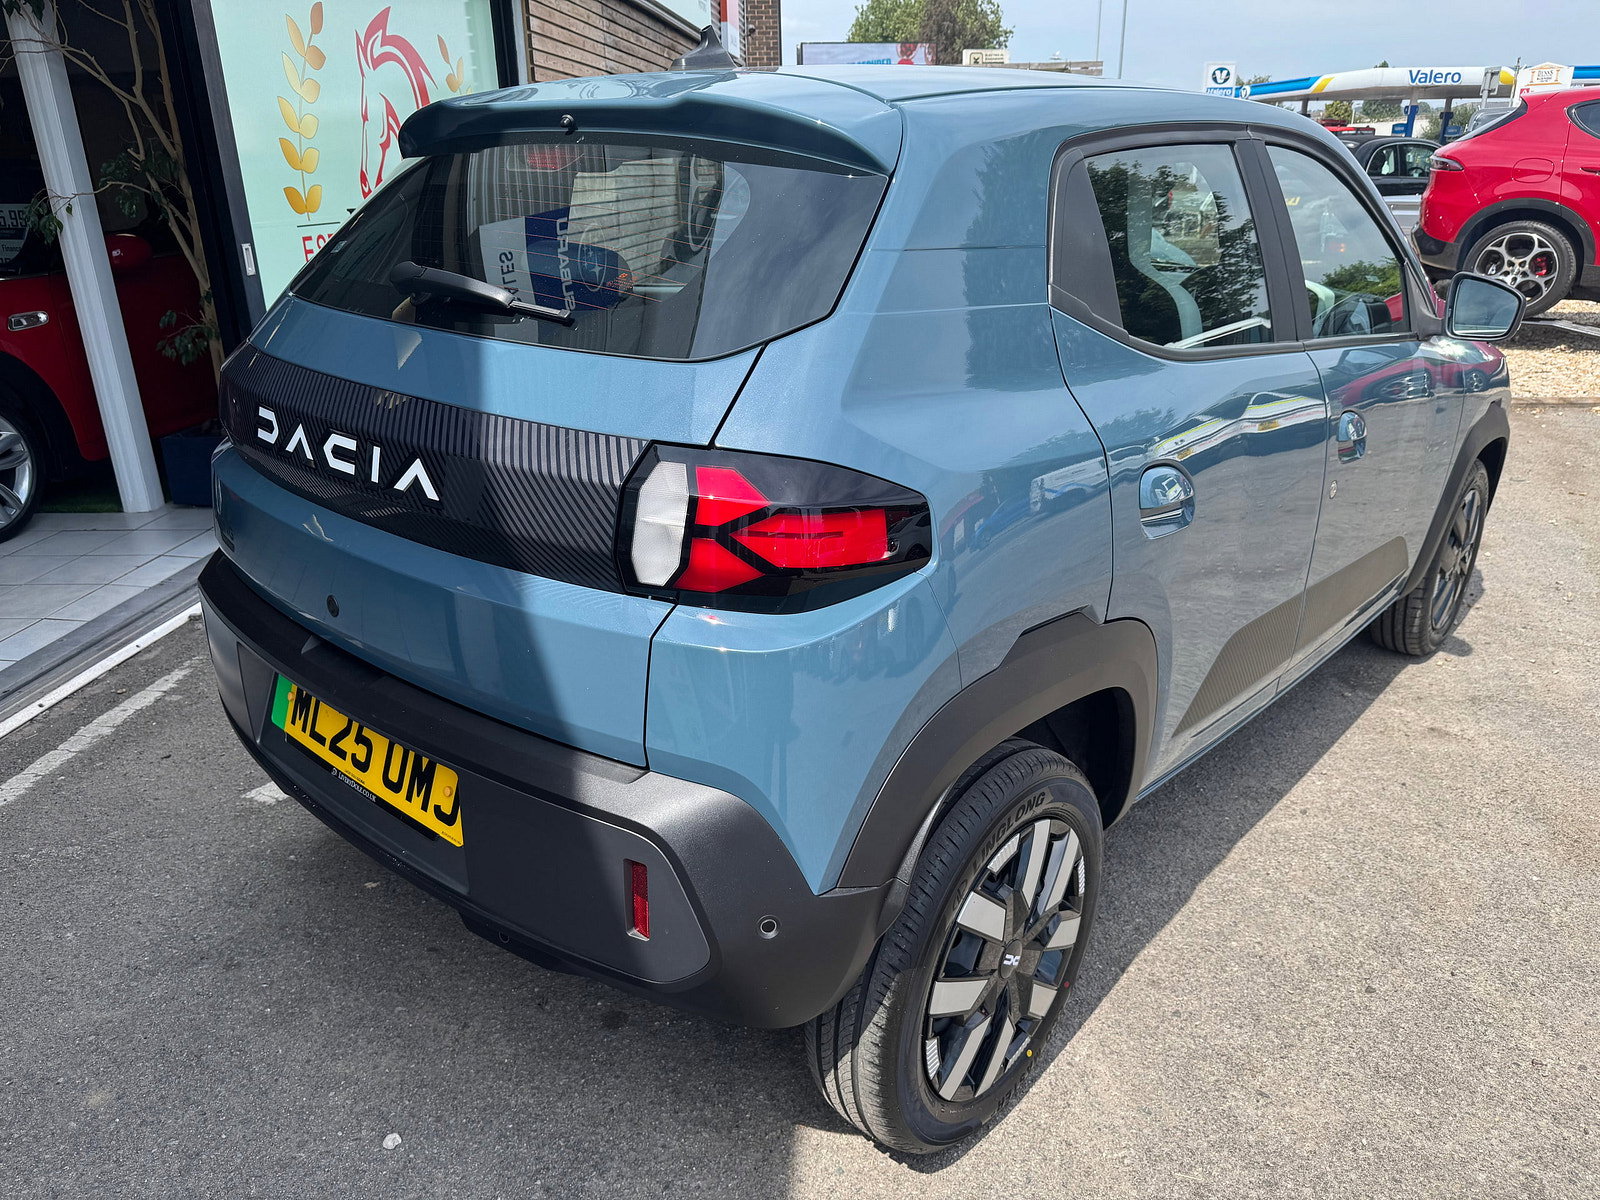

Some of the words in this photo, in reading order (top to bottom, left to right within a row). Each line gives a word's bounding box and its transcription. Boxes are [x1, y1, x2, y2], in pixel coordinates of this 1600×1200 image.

[1408, 69, 1462, 85] Valero
[257, 406, 440, 501] DACIA
[291, 686, 374, 774] ML25
